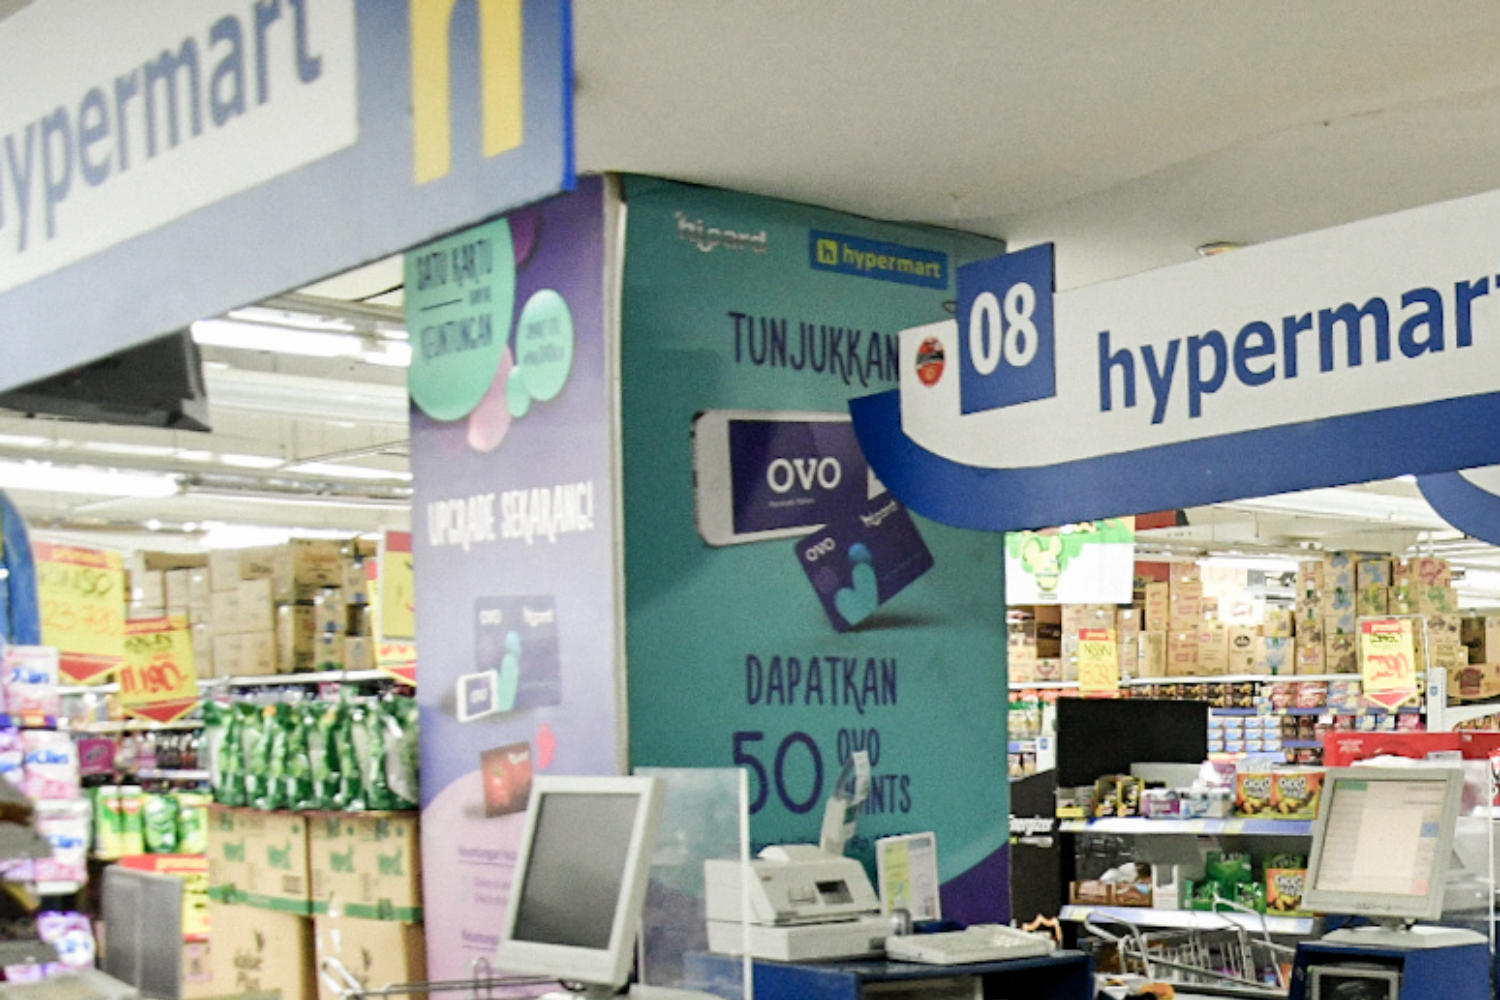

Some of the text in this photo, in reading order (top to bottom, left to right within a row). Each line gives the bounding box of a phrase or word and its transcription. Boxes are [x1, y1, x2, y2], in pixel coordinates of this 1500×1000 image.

[0, 0, 322, 252] ypermart
[842, 242, 942, 279] hypermart
[727, 311, 899, 388] TUNJUKKAN
[968, 281, 1038, 377] 08
[766, 456, 842, 494] OVO
[805, 537, 837, 562] OVO
[745, 654, 899, 715] DAPATKAN
[732, 730, 825, 815] 50
